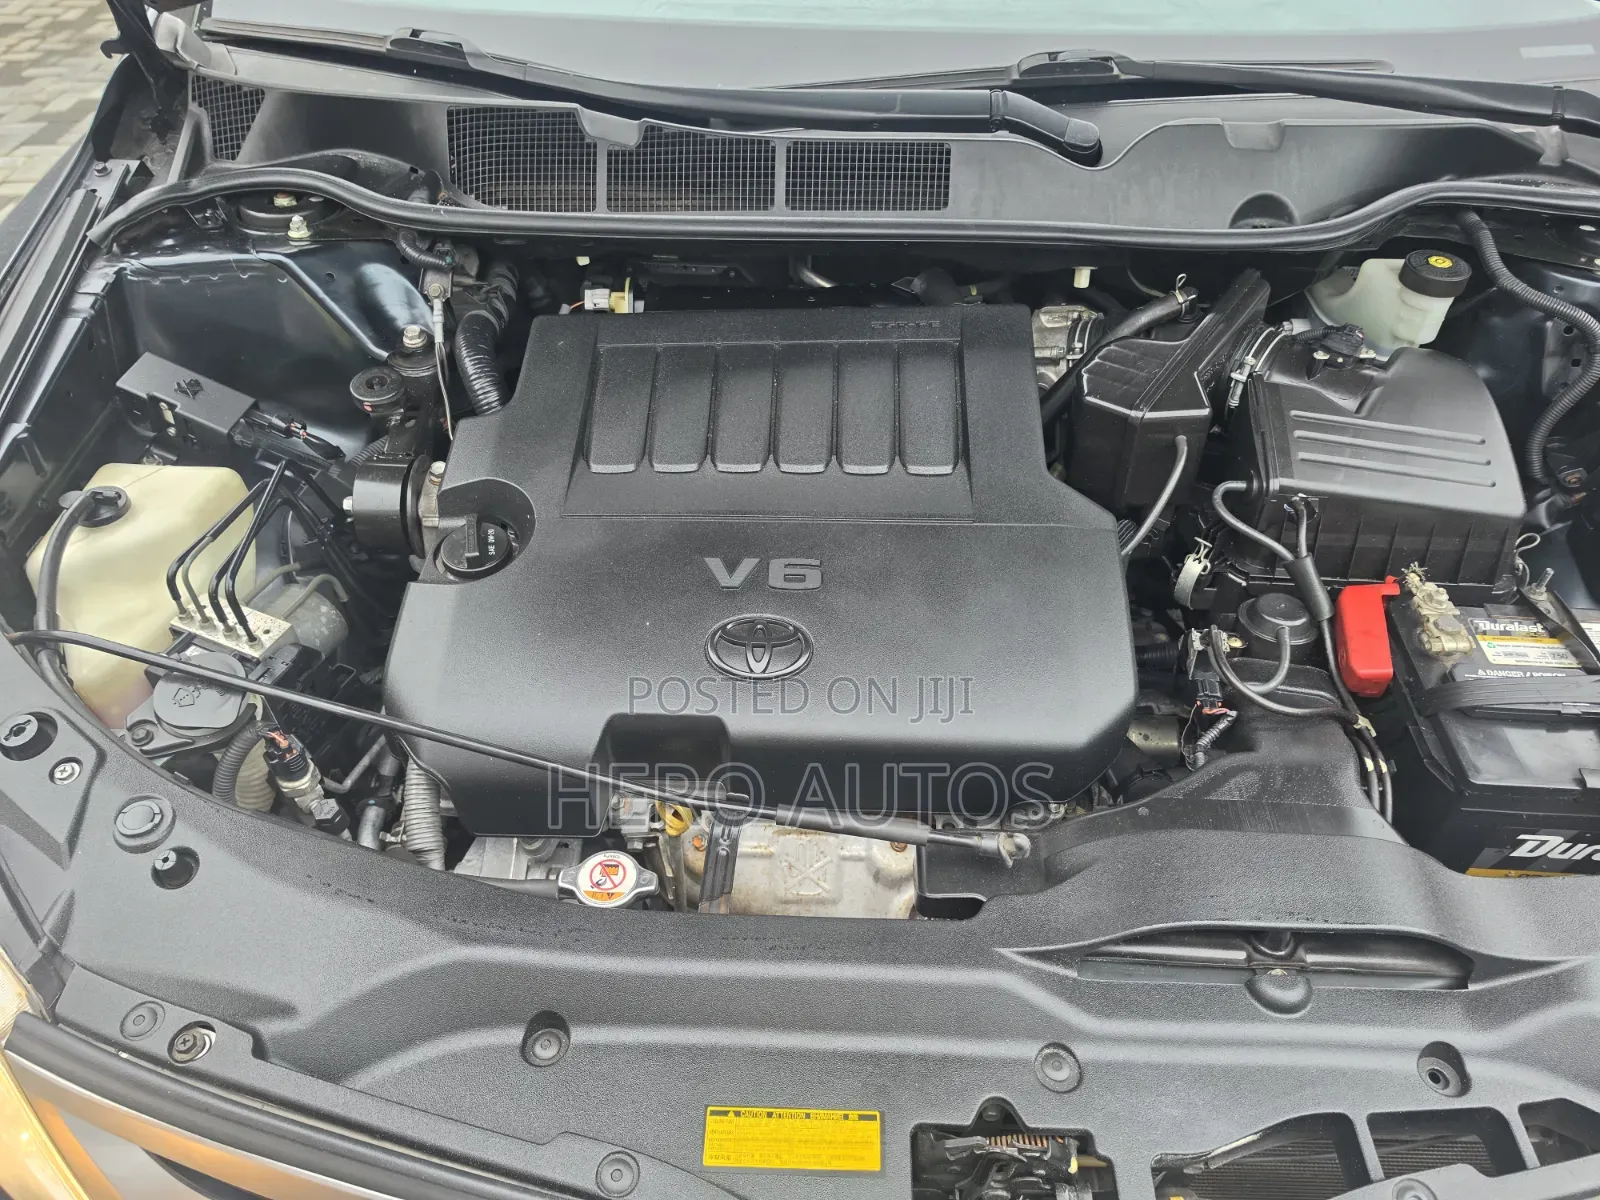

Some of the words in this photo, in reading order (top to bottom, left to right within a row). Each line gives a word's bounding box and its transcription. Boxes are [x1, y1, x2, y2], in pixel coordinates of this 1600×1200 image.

[704, 556, 823, 591] V6
[1474, 620, 1546, 633] Duralast
[740, 1110, 768, 1119] CAUTION
[771, 1112, 807, 1120] ATTENTION
